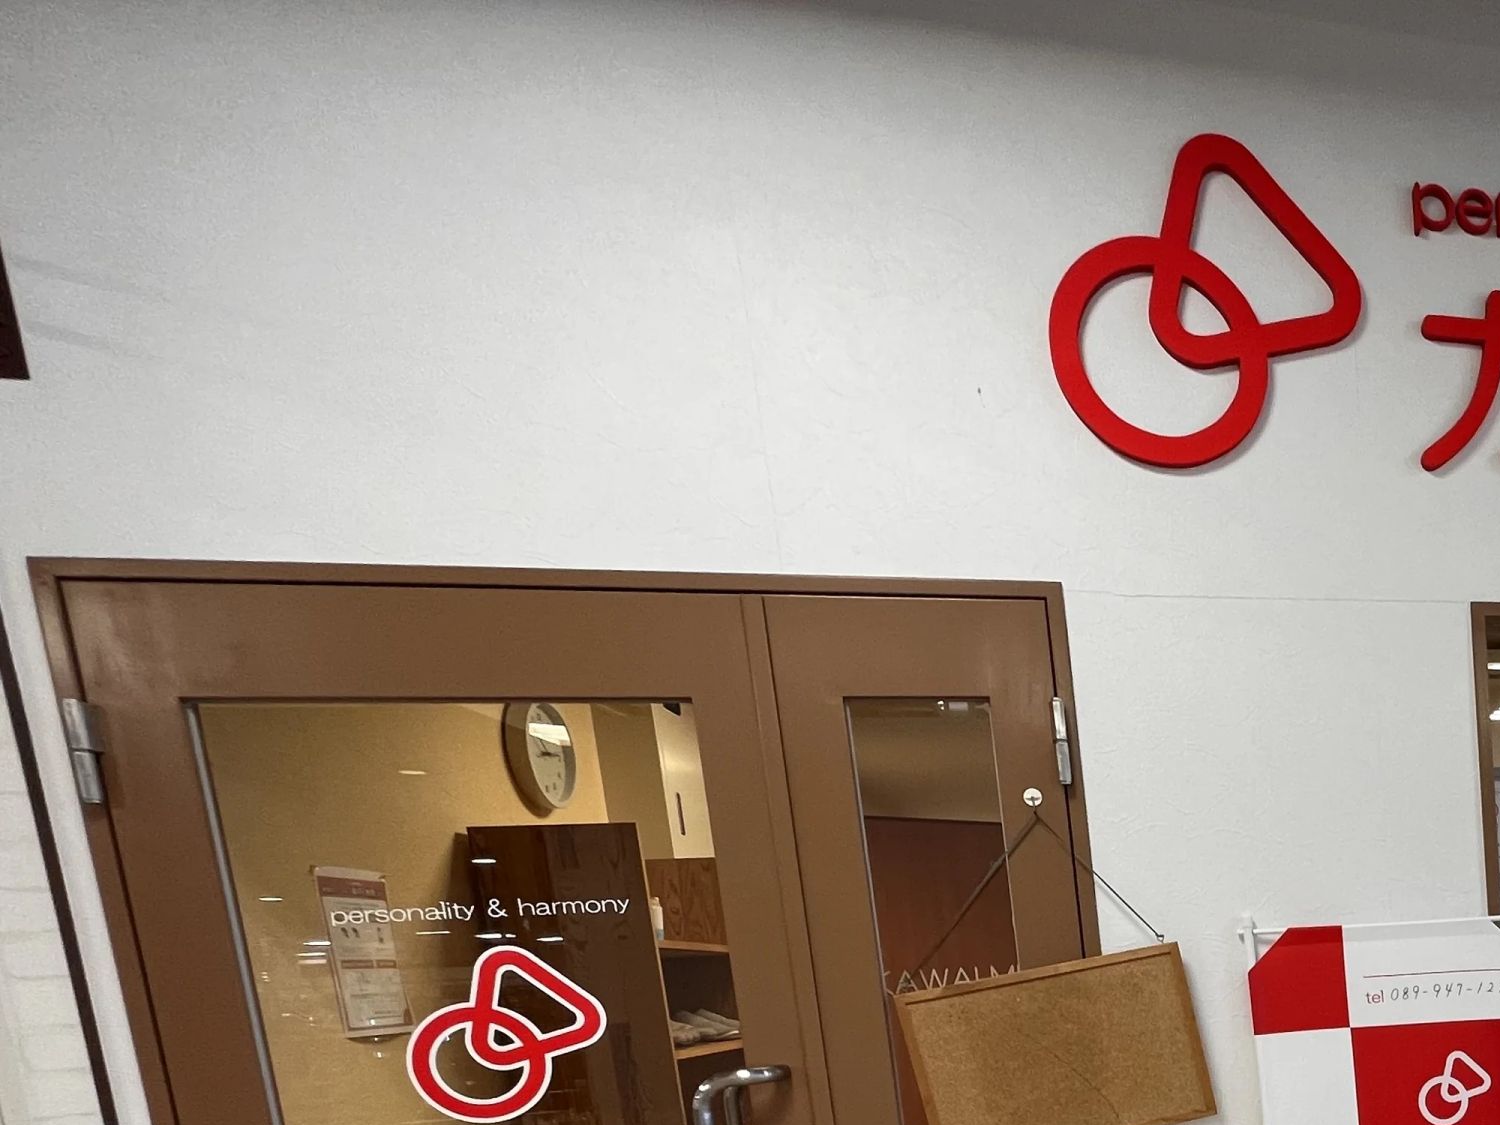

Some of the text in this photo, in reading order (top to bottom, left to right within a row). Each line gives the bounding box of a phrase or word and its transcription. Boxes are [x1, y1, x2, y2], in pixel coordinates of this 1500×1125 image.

[330, 897, 630, 928] personality & harmony
[1366, 989, 1385, 1004] tel
